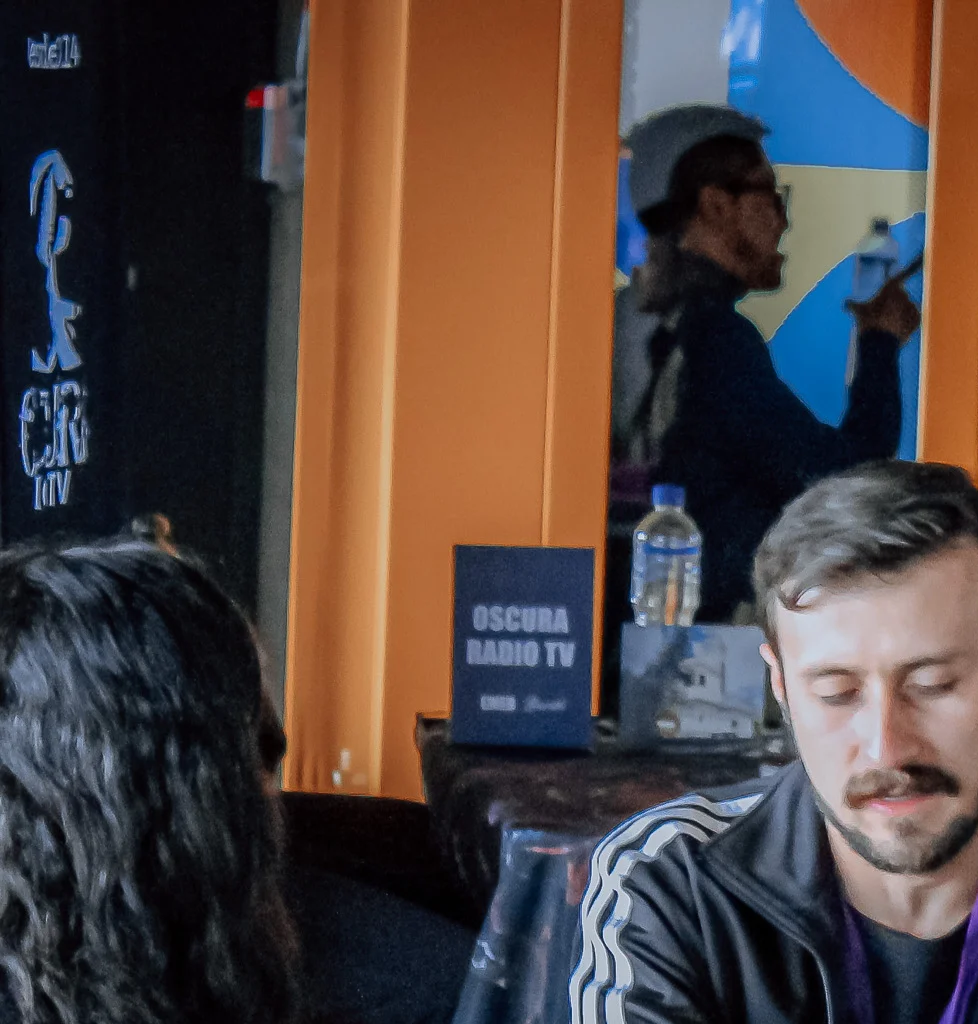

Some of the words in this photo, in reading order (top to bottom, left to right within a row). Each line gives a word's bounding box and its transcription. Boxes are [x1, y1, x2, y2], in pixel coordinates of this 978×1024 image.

[473, 605, 570, 633] OSCURA
[466, 638, 540, 667] RADIO
[543, 641, 576, 667] TV
